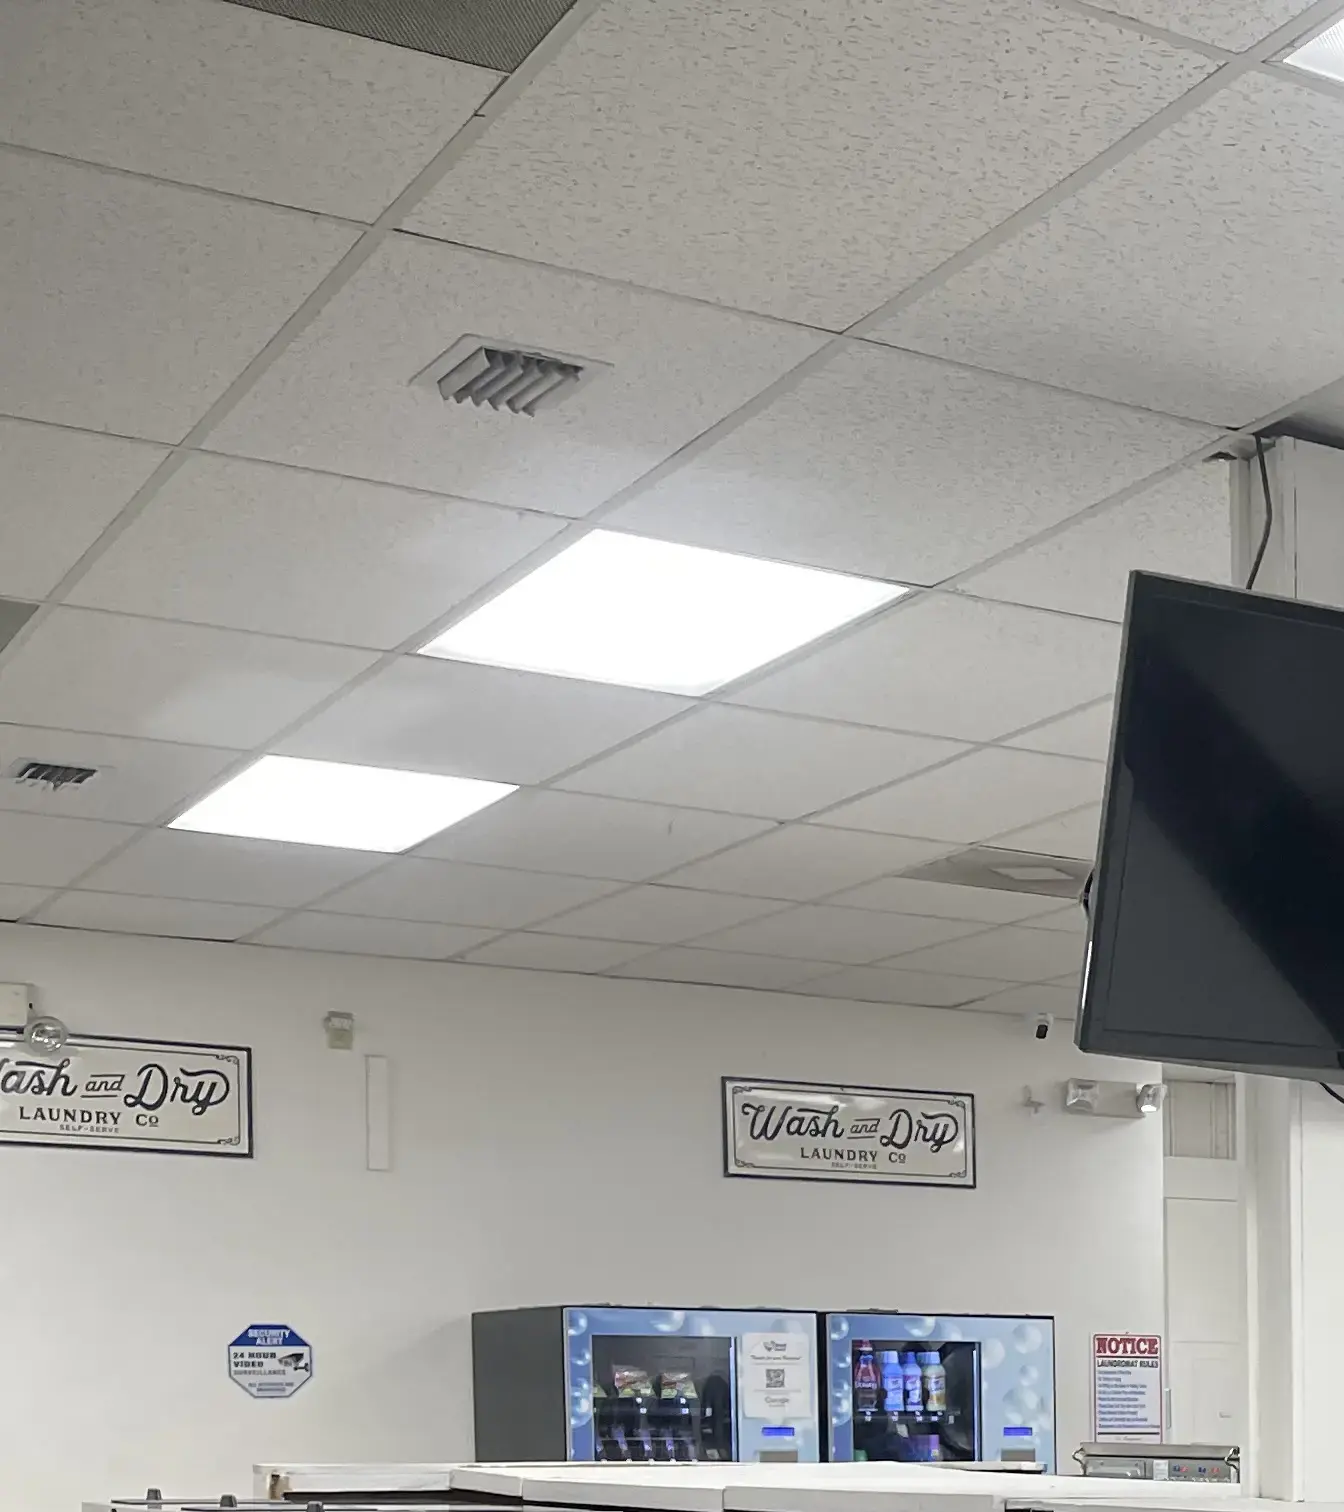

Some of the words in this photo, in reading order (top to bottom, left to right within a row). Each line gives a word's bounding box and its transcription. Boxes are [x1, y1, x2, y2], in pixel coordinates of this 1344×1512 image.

[82, 1074, 125, 1092] and
[123, 1063, 230, 1116] Dry
[19, 1106, 122, 1125] LAUNDRY
[741, 1102, 844, 1141] Wash
[849, 1118, 881, 1134] and
[879, 1108, 959, 1152] Dry
[800, 1147, 878, 1162] LAUNDRY
[1096, 1337, 1158, 1354] NOTICE
